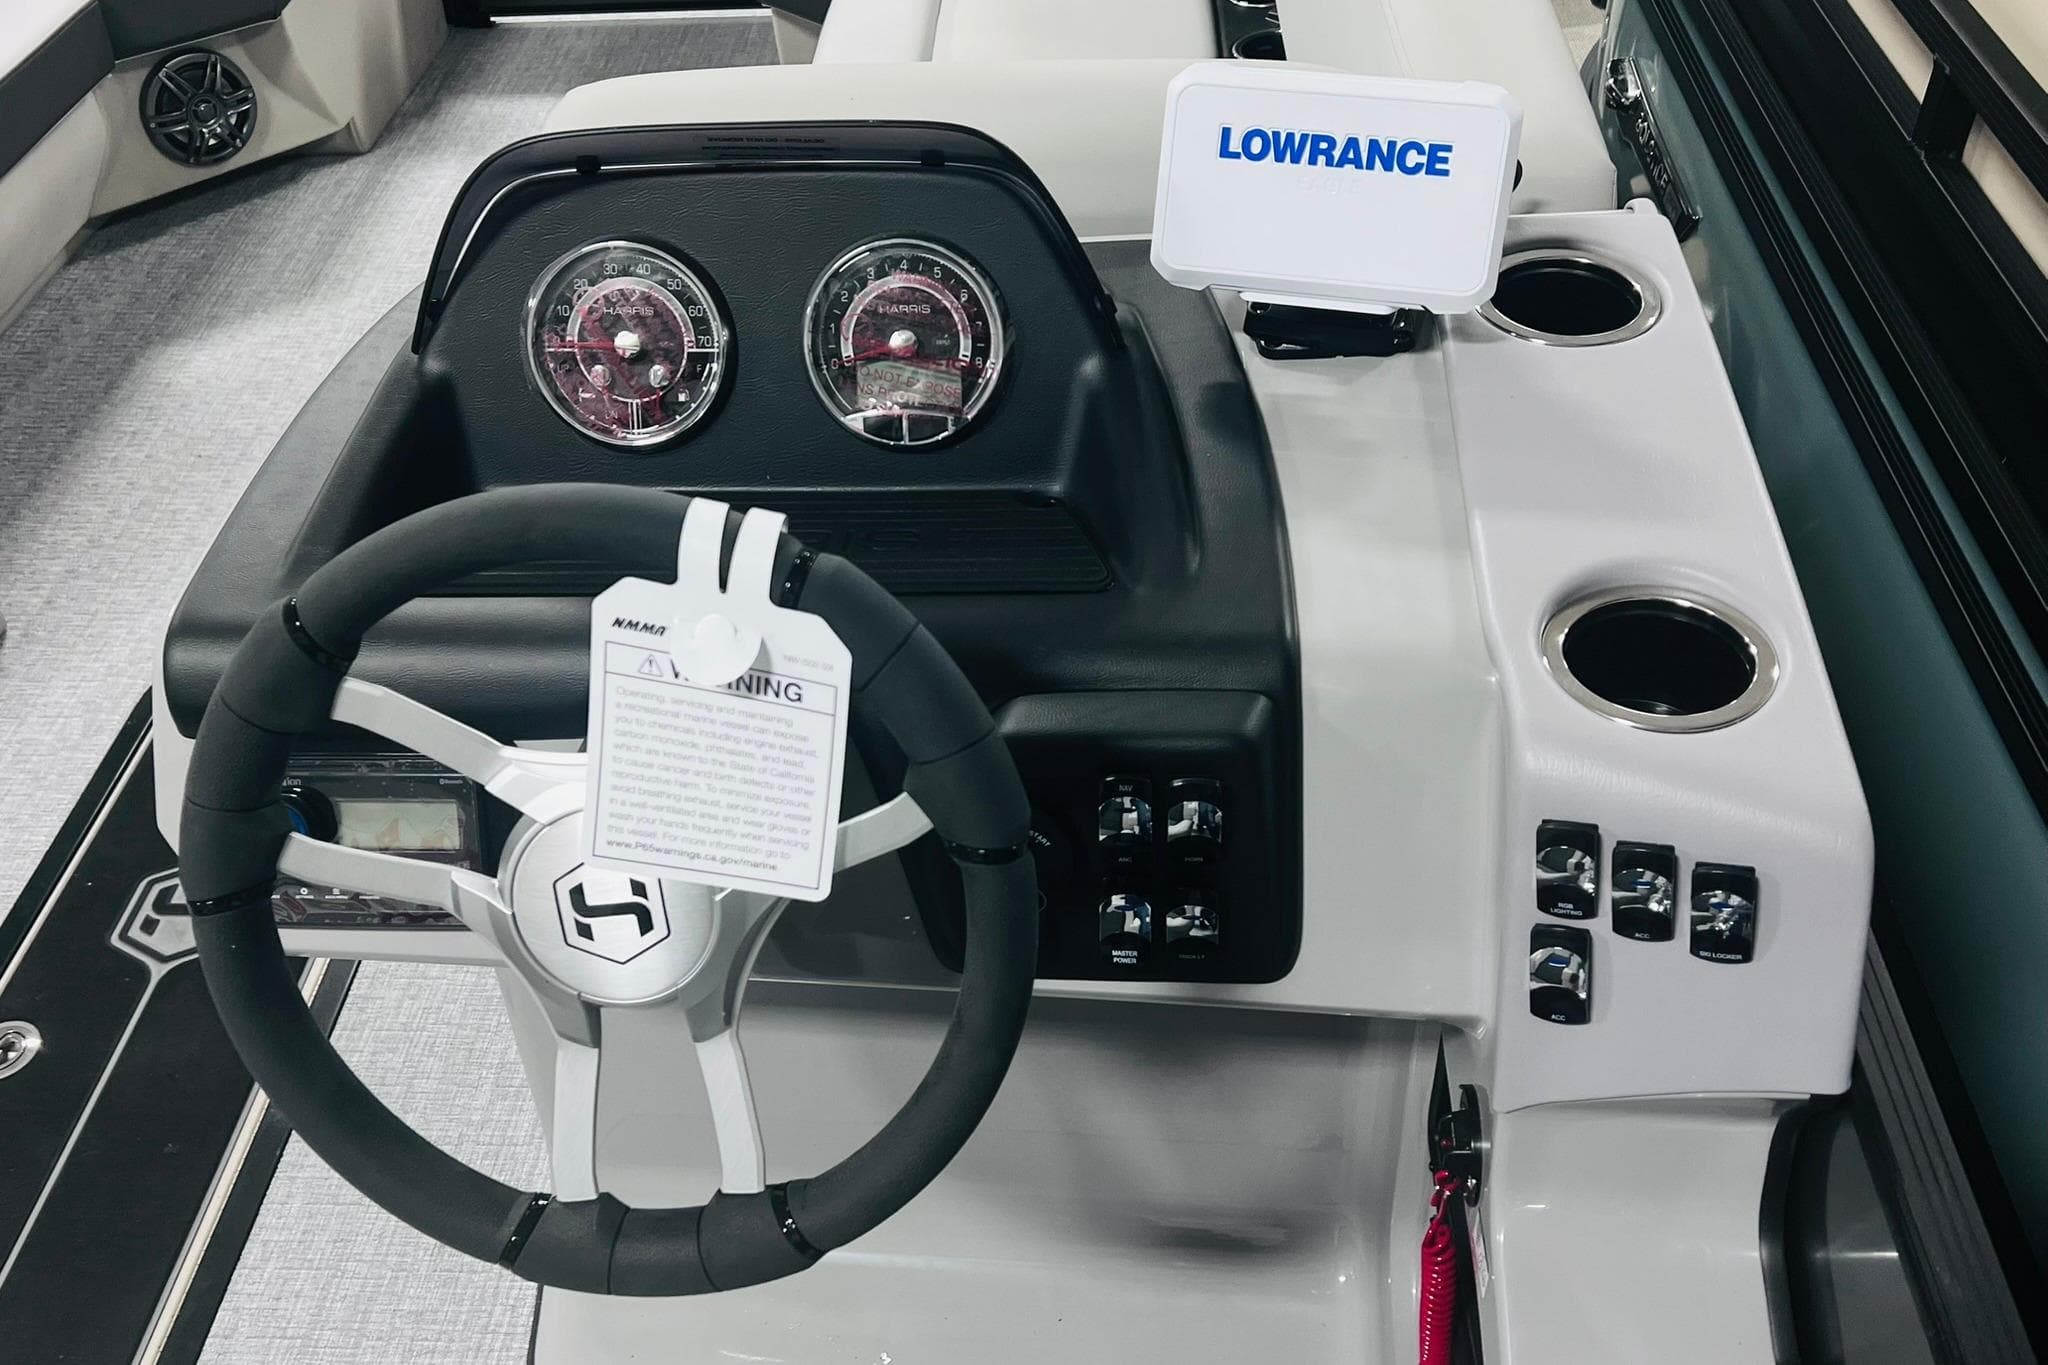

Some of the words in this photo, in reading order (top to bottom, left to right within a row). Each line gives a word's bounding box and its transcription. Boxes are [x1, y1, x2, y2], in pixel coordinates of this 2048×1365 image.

[1218, 126, 1453, 177] LOWRANCE
[603, 264, 618, 274] 30
[636, 264, 650, 274] 40
[900, 260, 908, 269] 4
[867, 268, 875, 278] 3
[934, 267, 942, 278] 5
[574, 279, 588, 290] 20
[667, 279, 682, 290] 50
[841, 291, 849, 302] 2
[961, 290, 968, 301] 6
[557, 305, 570, 316] 10
[604, 306, 654, 316] HARRIS
[689, 306, 703, 316] 60
[879, 304, 931, 314] HARRIS
[829, 324, 835, 334] 1
[698, 336, 712, 347] 70
[975, 357, 982, 368] 8
[612, 617, 666, 637] NMMA
[1550, 907, 1582, 916] LIGHTING
